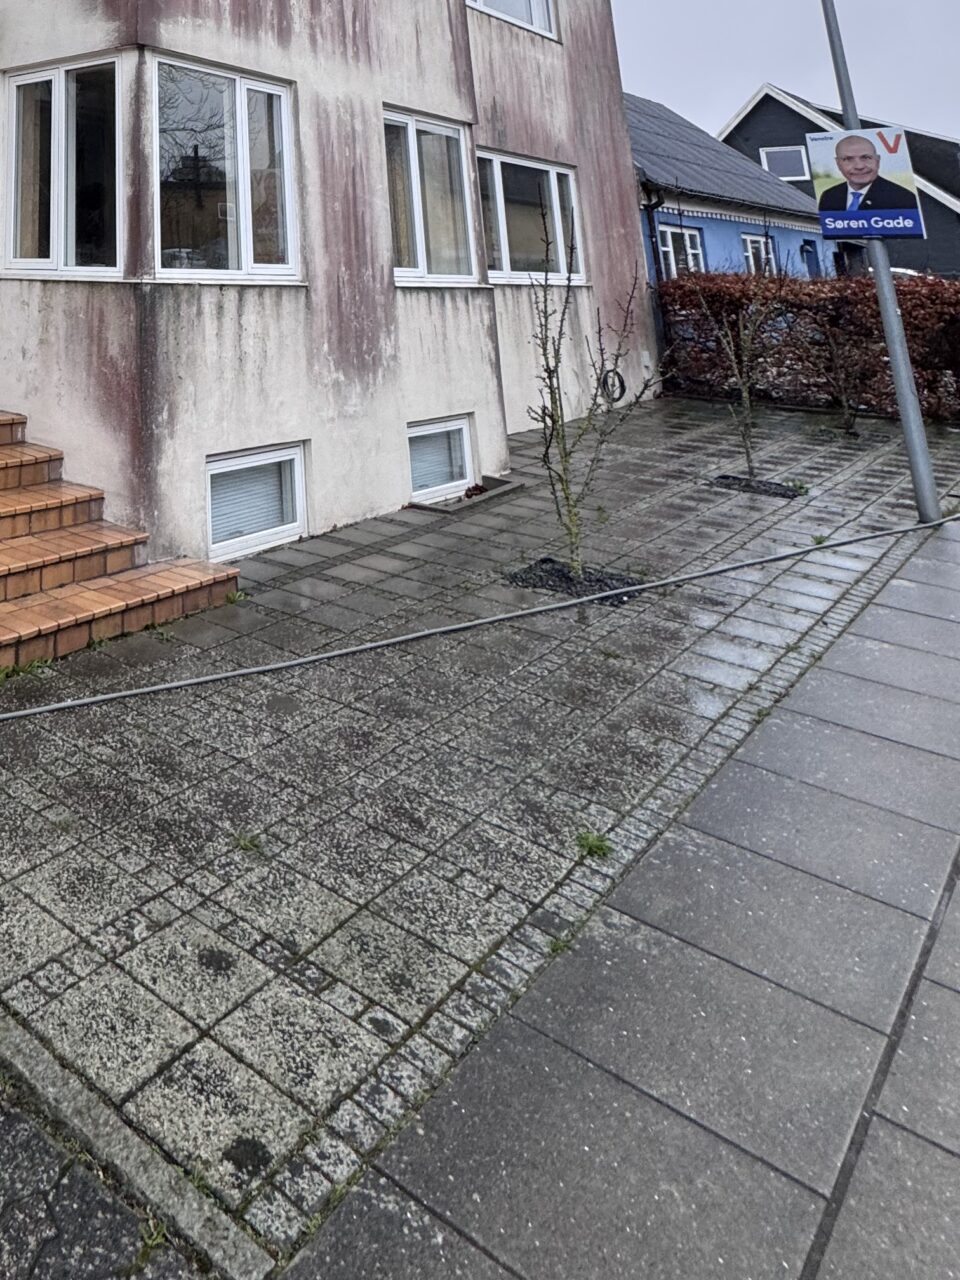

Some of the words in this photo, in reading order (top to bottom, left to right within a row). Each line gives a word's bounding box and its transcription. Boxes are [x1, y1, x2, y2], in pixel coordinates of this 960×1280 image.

[877, 131, 902, 154] V
[825, 217, 868, 228] Søren
[870, 216, 914, 227] Gade
